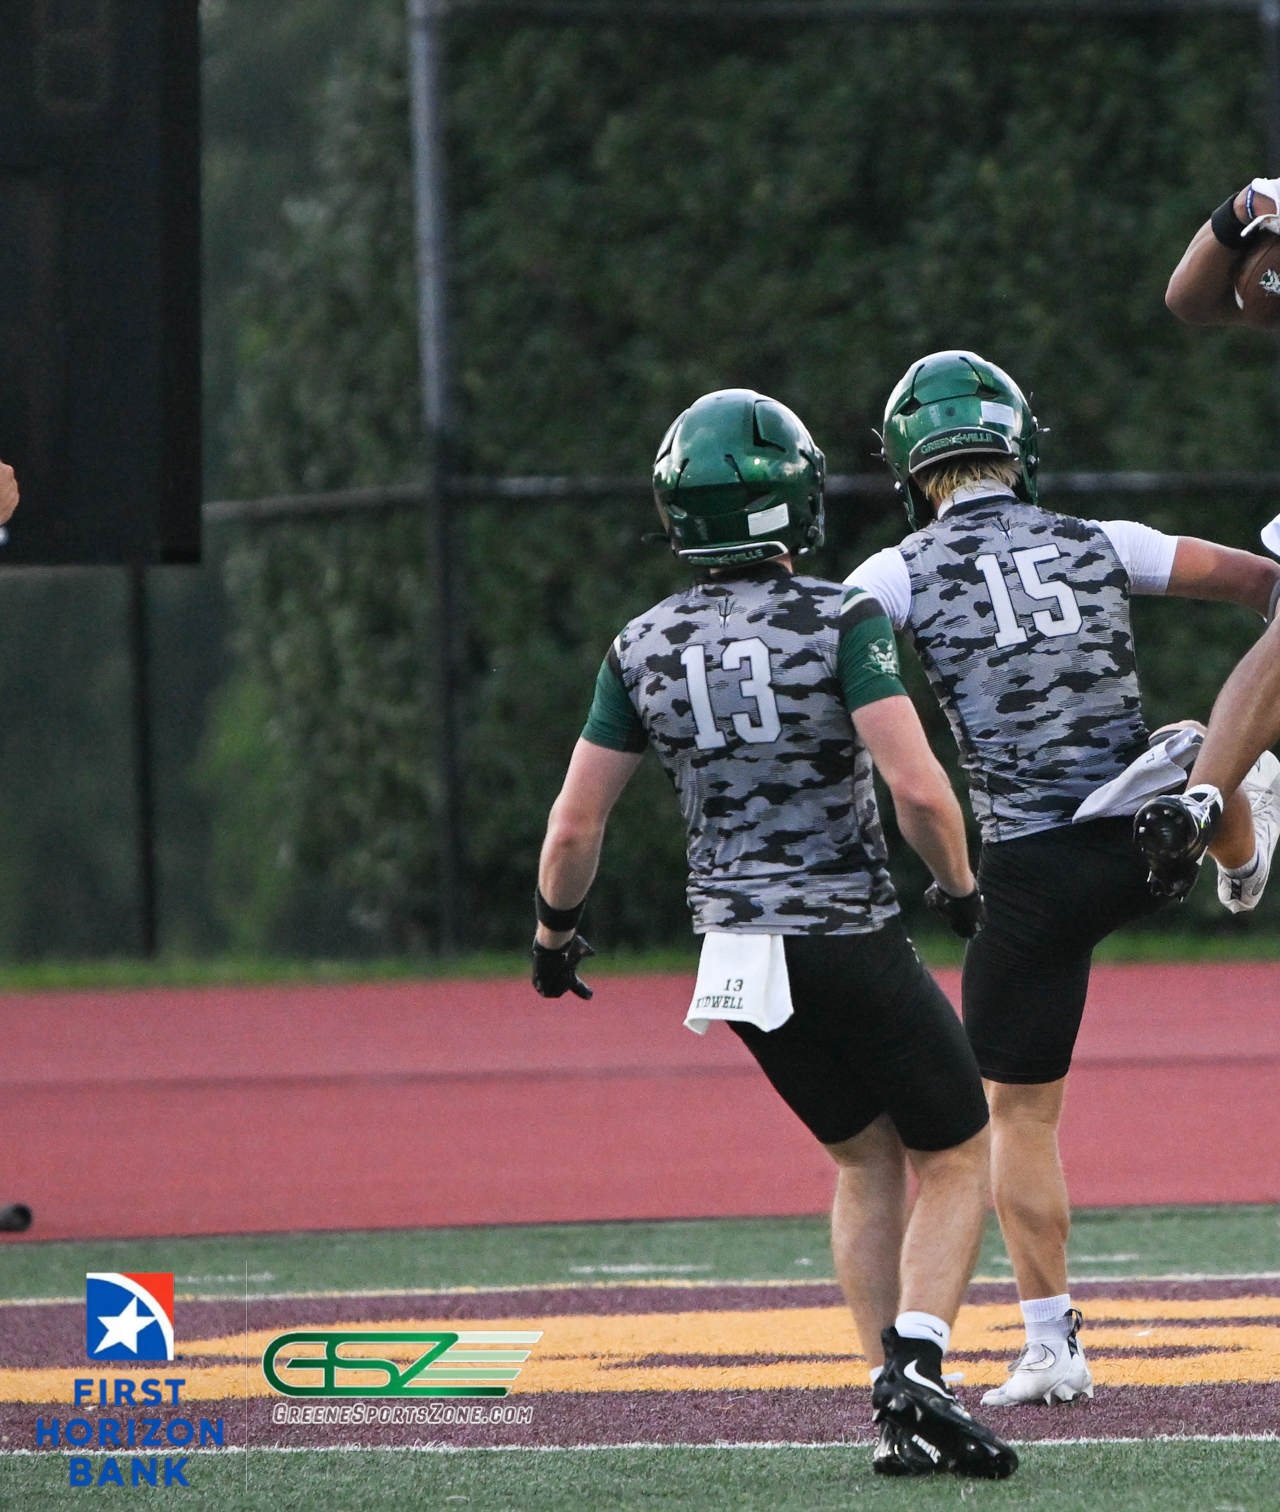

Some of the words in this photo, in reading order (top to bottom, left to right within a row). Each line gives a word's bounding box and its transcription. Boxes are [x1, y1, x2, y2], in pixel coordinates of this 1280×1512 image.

[975, 543, 1083, 649] 15
[680, 636, 782, 749] 13
[723, 978, 744, 992] 13
